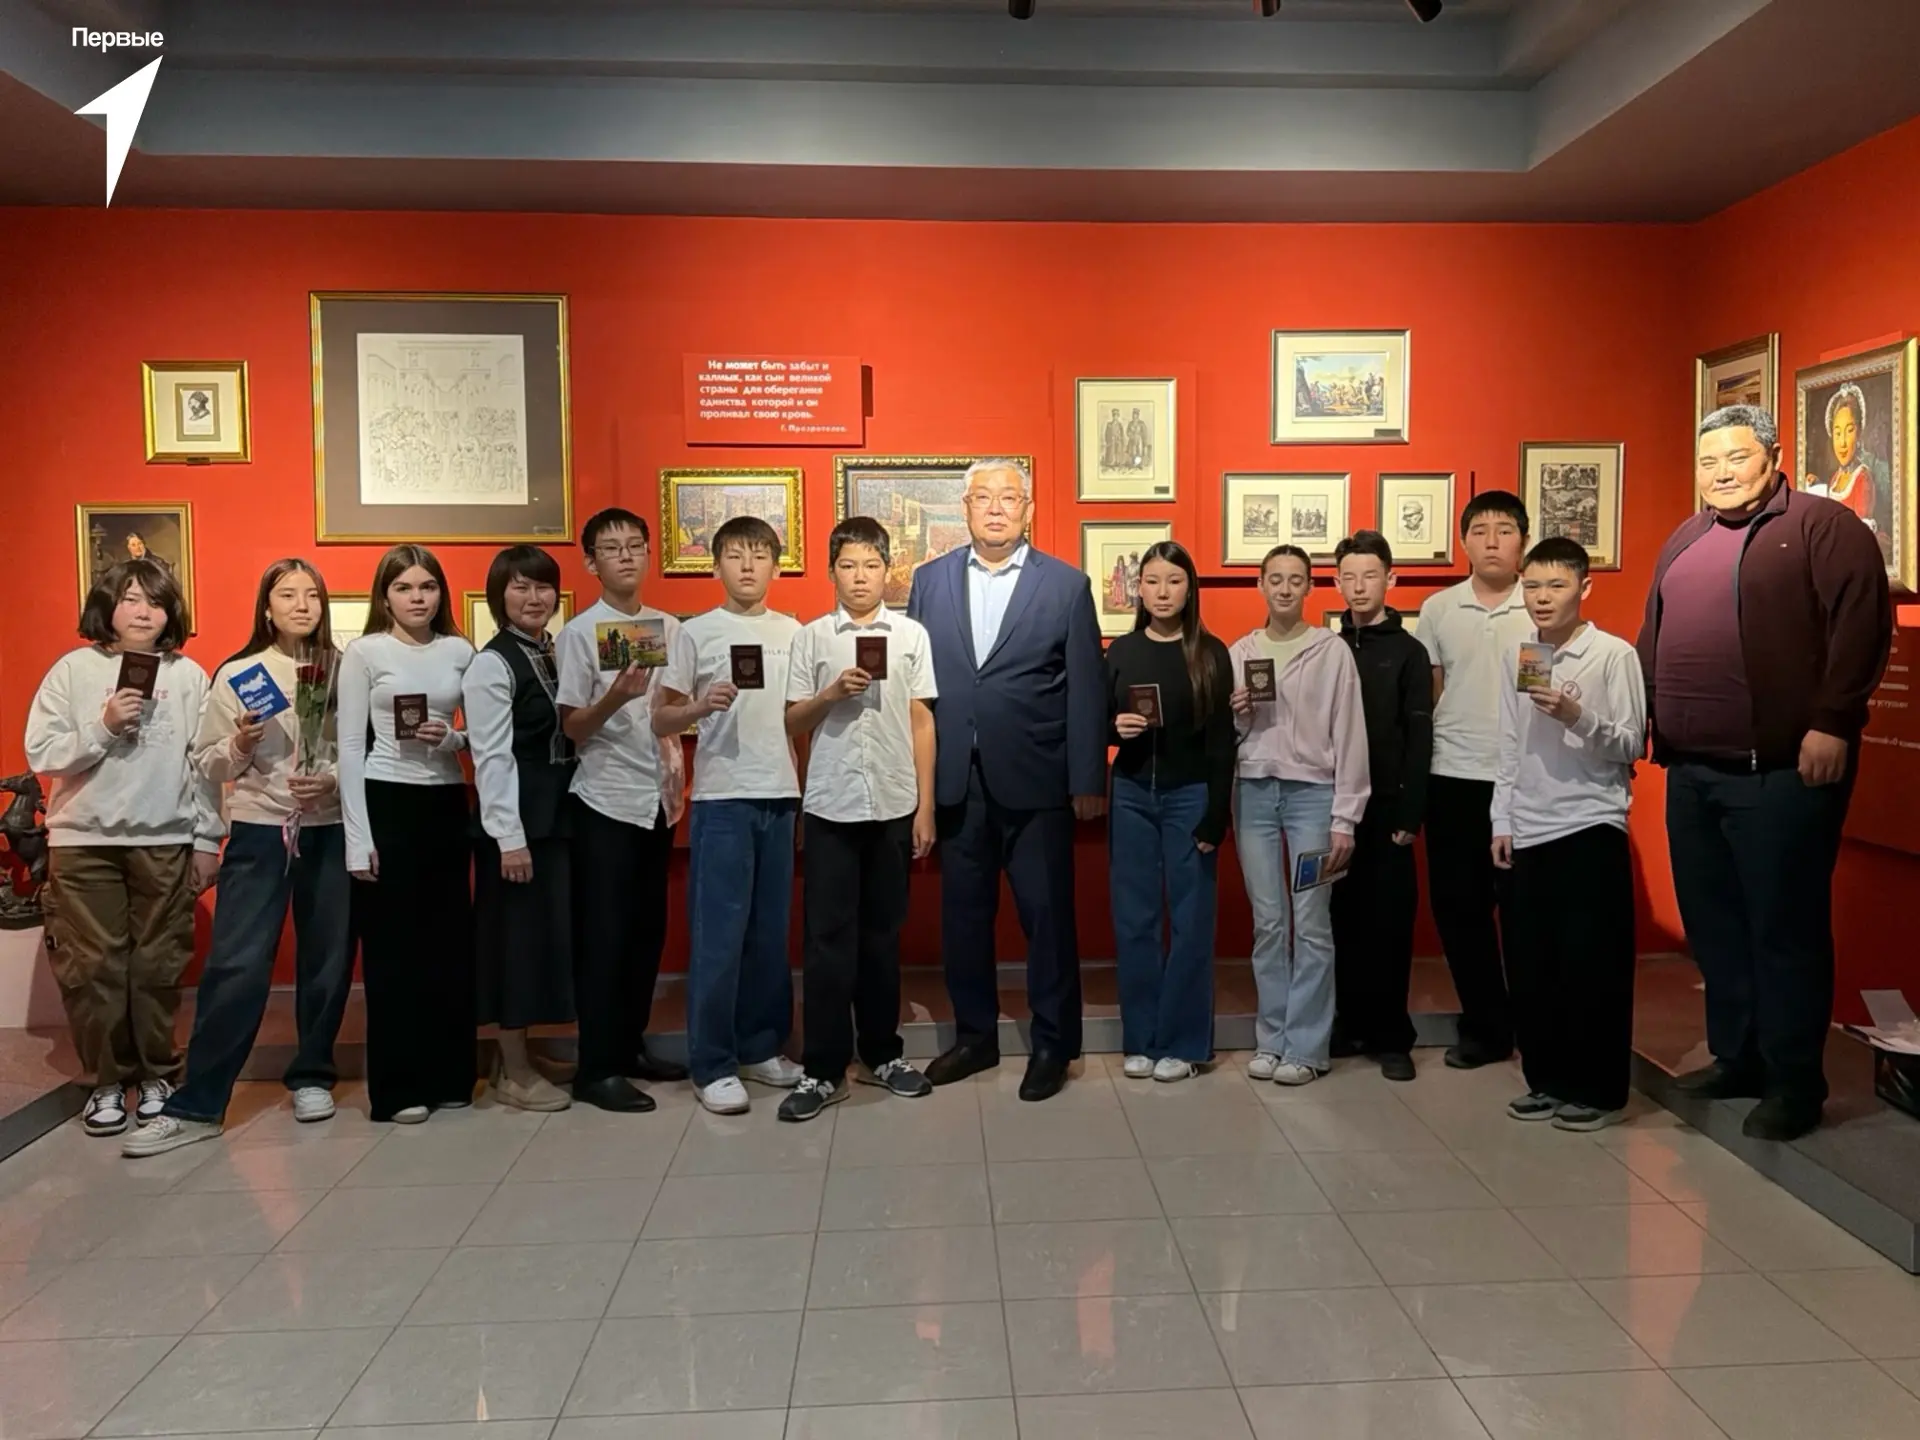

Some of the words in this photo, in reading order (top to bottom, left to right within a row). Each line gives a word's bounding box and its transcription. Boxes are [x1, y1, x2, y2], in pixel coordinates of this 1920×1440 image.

[708, 361, 723, 370] Не
[725, 362, 759, 370] может
[761, 360, 787, 371] быть
[789, 361, 820, 371] забыт
[745, 374, 763, 382] как
[765, 374, 785, 382] сын
[789, 373, 832, 382] великой
[700, 386, 738, 395] страны
[743, 386, 762, 395] для
[764, 385, 824, 396] оберегания
[700, 399, 747, 407] единства
[752, 398, 794, 408] которой
[700, 411, 750, 420] проливал
